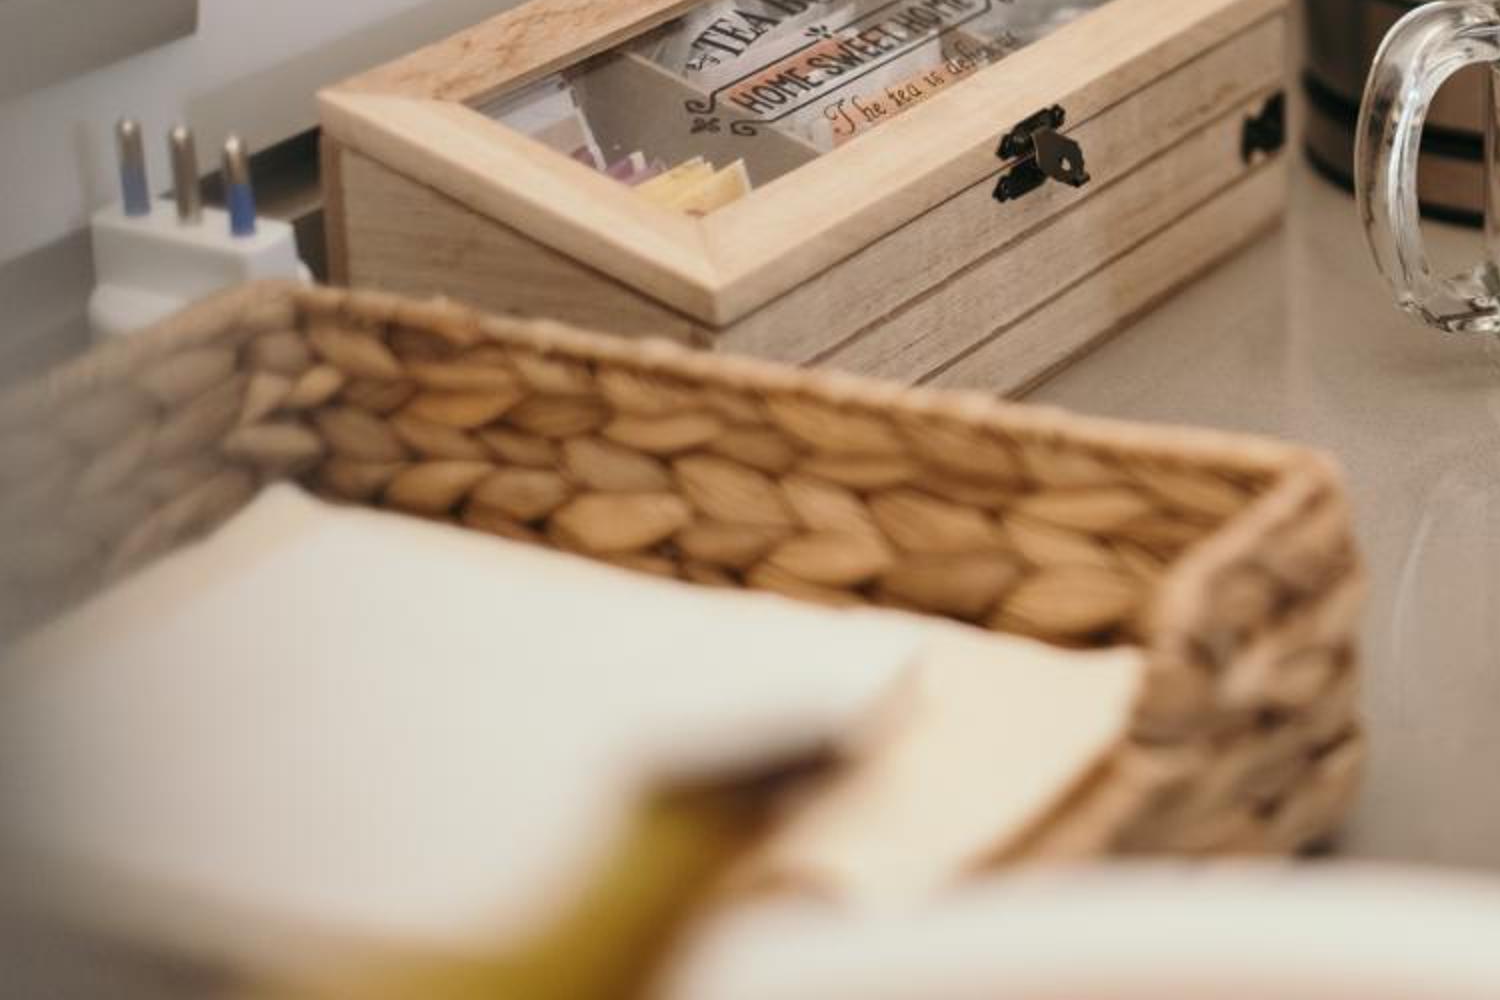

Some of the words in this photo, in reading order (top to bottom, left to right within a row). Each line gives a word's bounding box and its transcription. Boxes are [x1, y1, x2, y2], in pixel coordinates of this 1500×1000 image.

[690, 8, 782, 57] TEA
[729, 66, 825, 116] HOME
[807, 21, 908, 77] SWEET
[823, 95, 887, 135] The
[886, 84, 922, 108] tea
[923, 71, 946, 88] is
